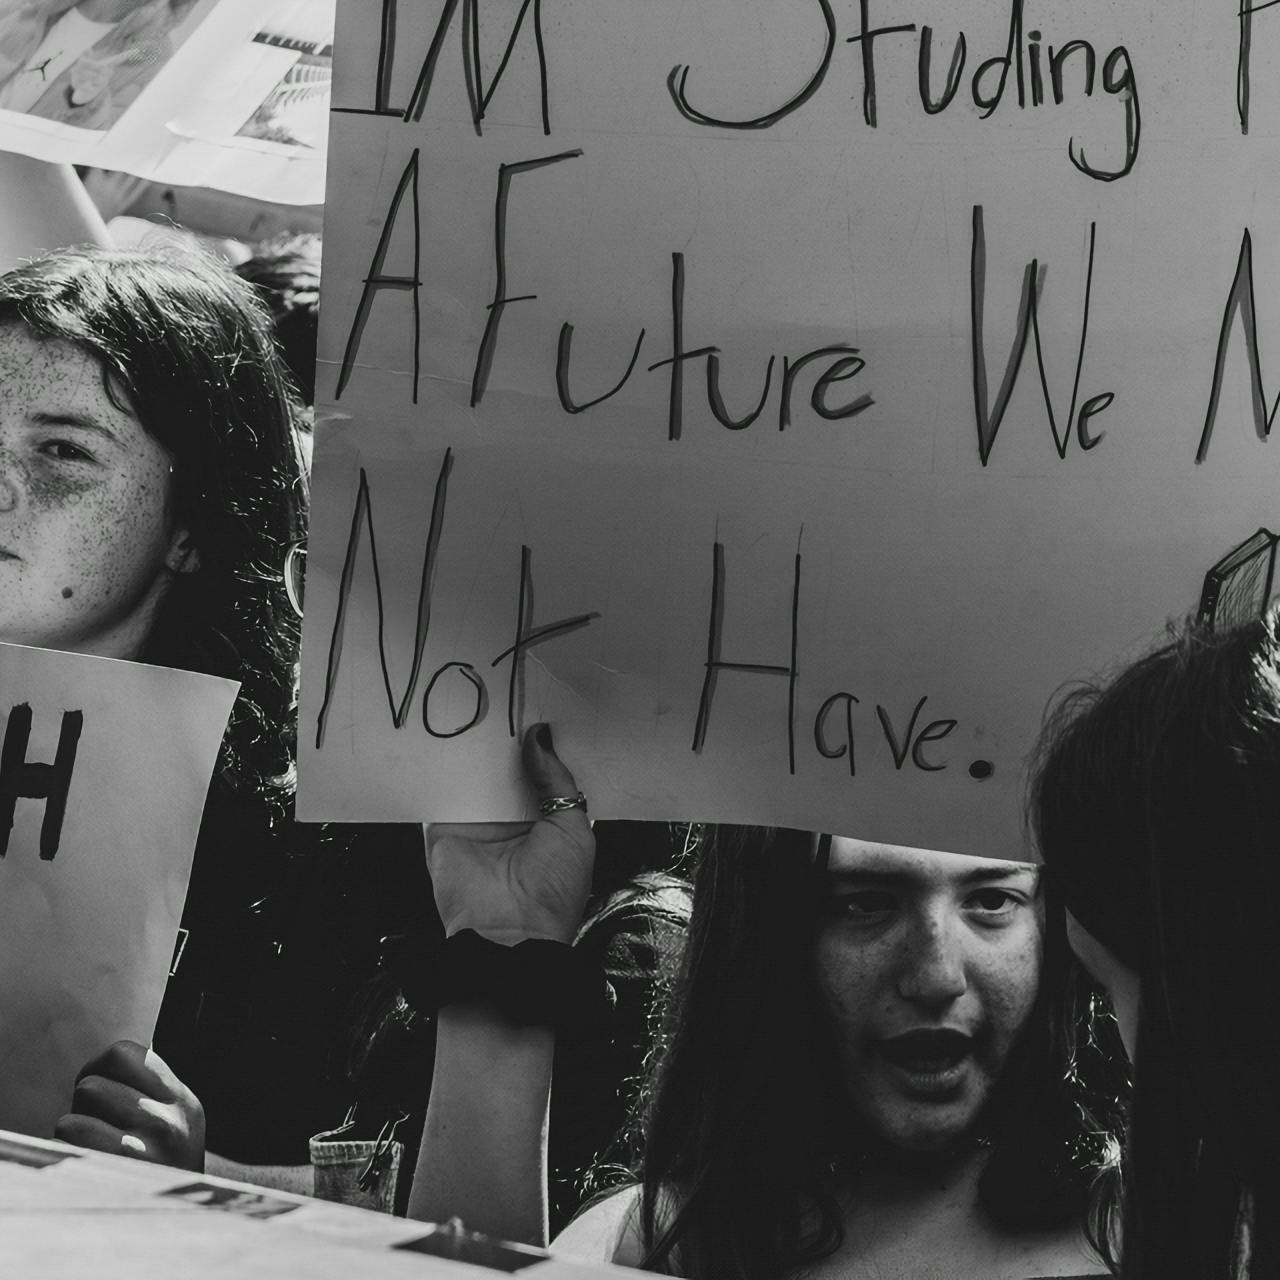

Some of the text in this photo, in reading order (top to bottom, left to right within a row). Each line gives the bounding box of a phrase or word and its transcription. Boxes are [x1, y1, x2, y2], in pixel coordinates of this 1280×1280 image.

[334, 147, 422, 405] A
[970, 205, 1115, 466] We
[314, 447, 600, 750] Not
